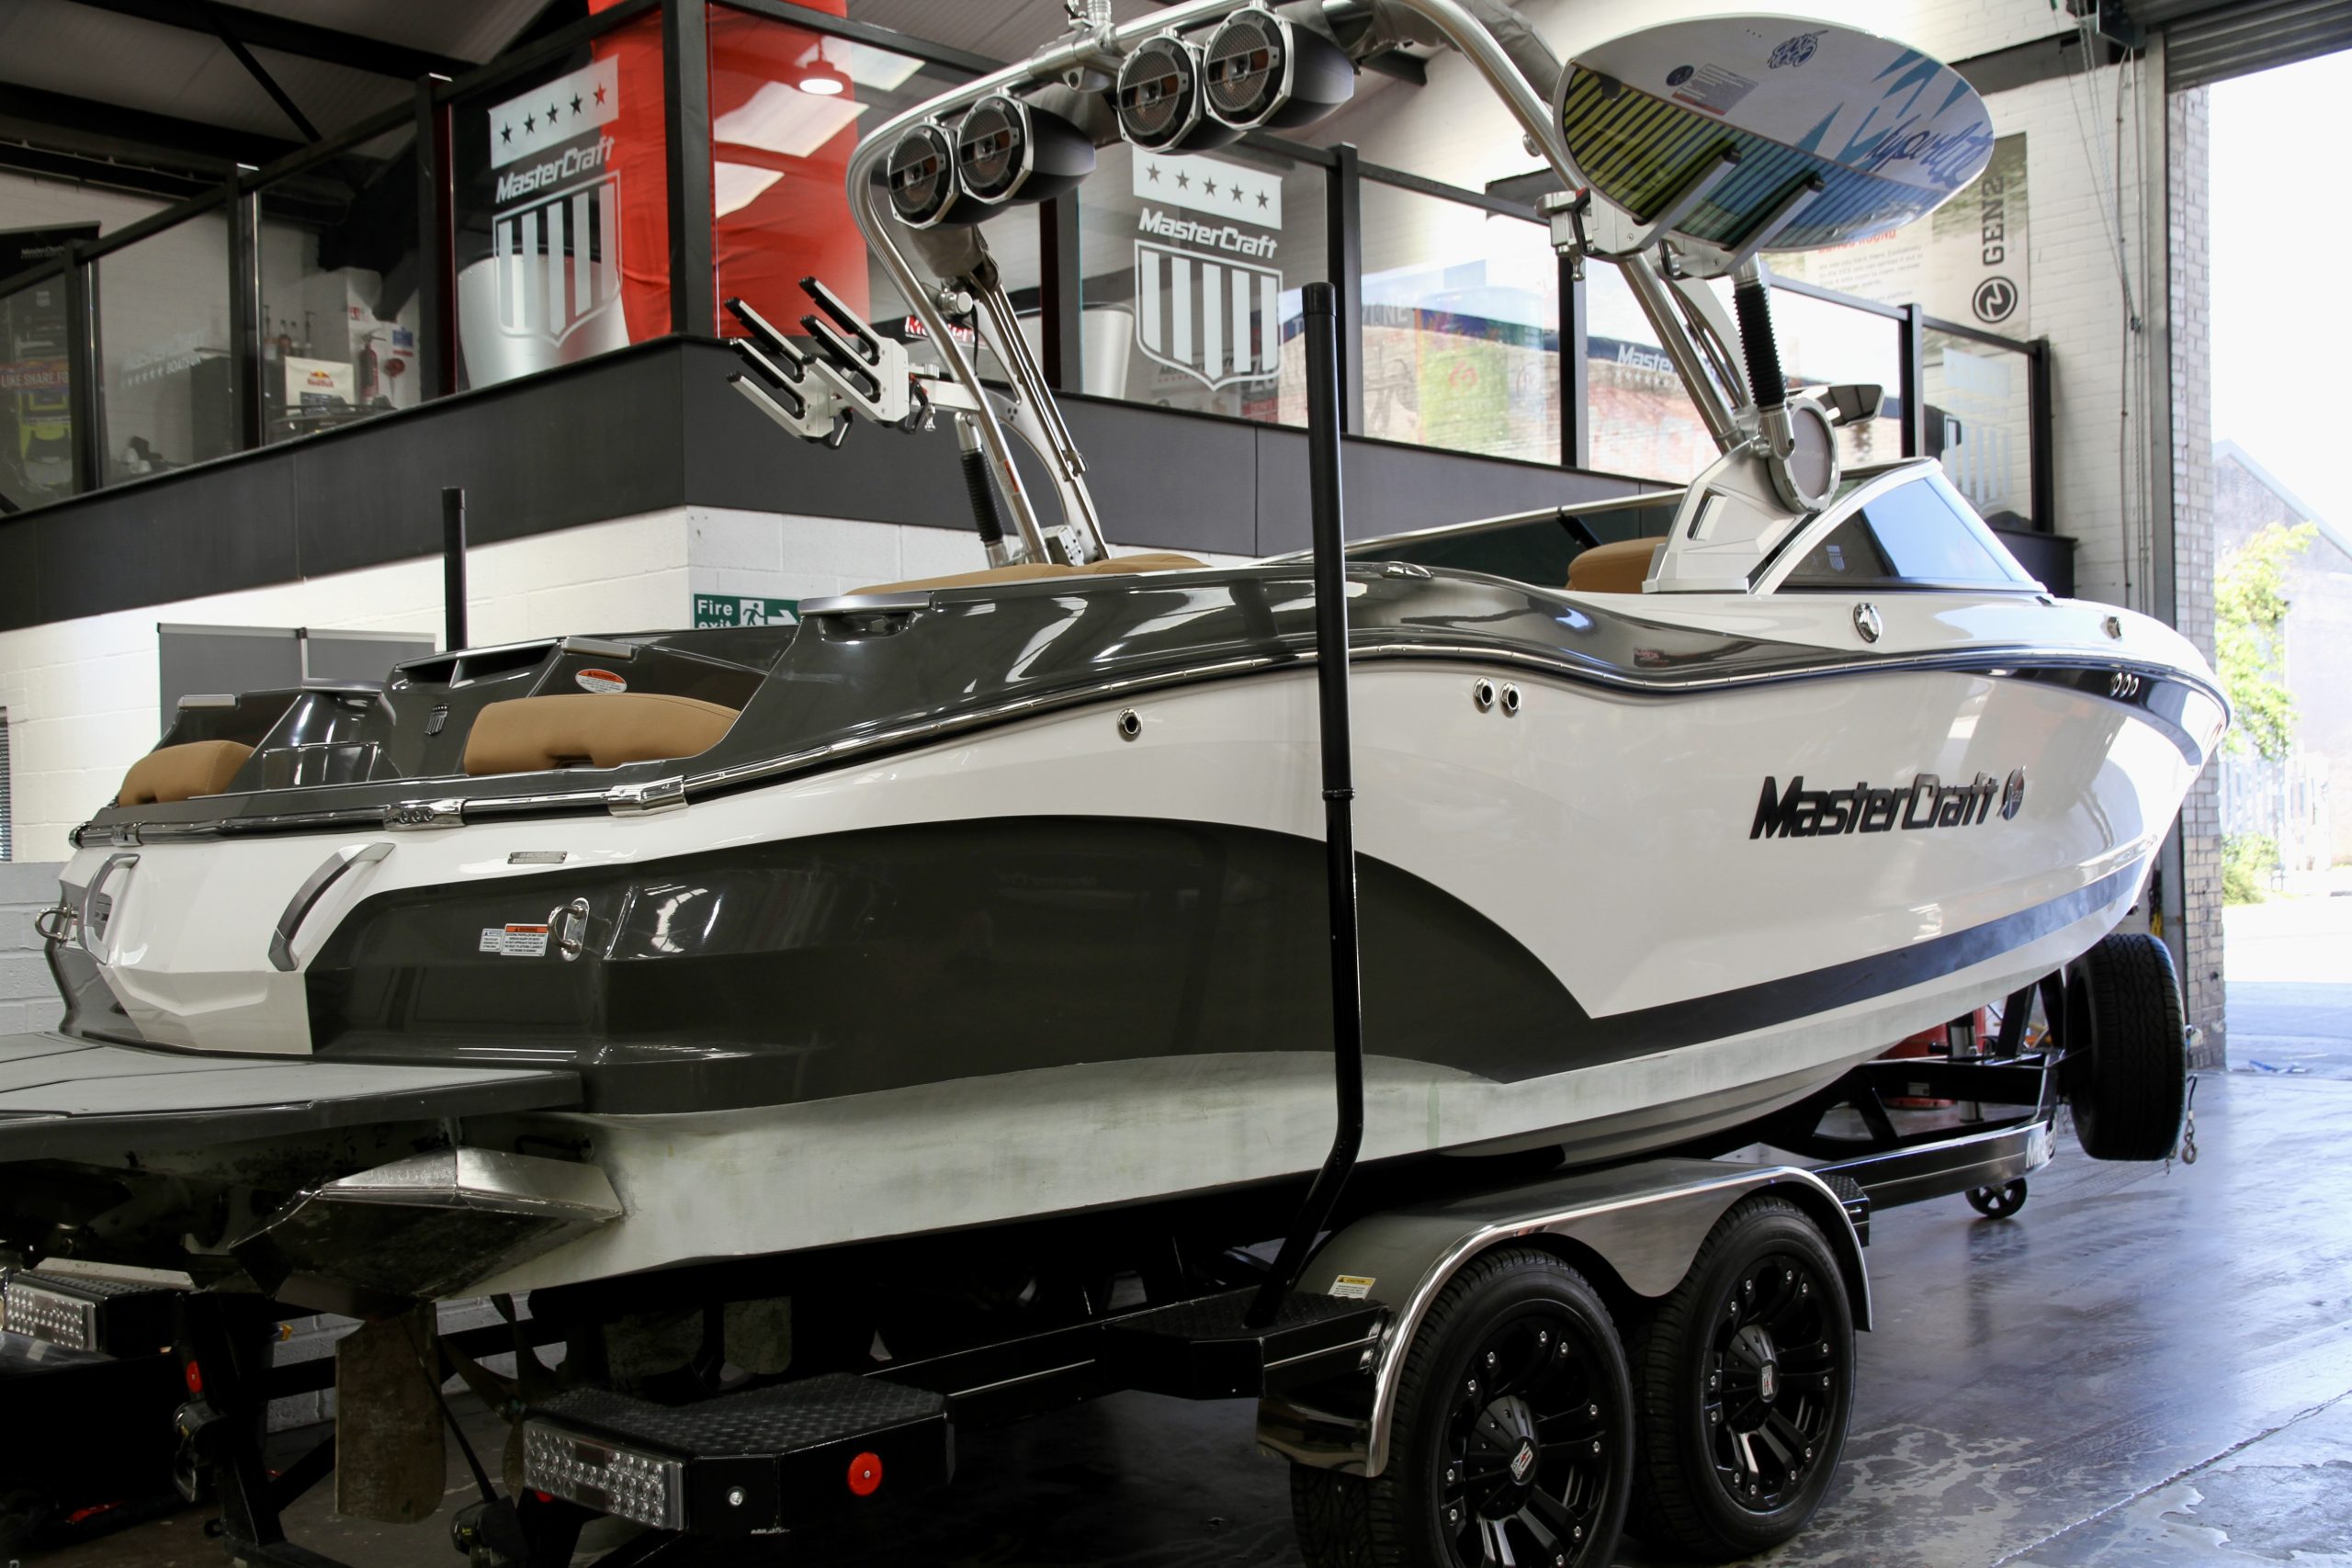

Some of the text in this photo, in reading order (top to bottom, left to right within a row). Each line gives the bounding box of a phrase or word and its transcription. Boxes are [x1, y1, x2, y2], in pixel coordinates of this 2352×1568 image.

[496, 135, 615, 204] MasterCraft
[1138, 207, 1277, 259] MasterCraft
[697, 599, 733, 616] Fire
[1748, 772, 1999, 840] MasterCraft
